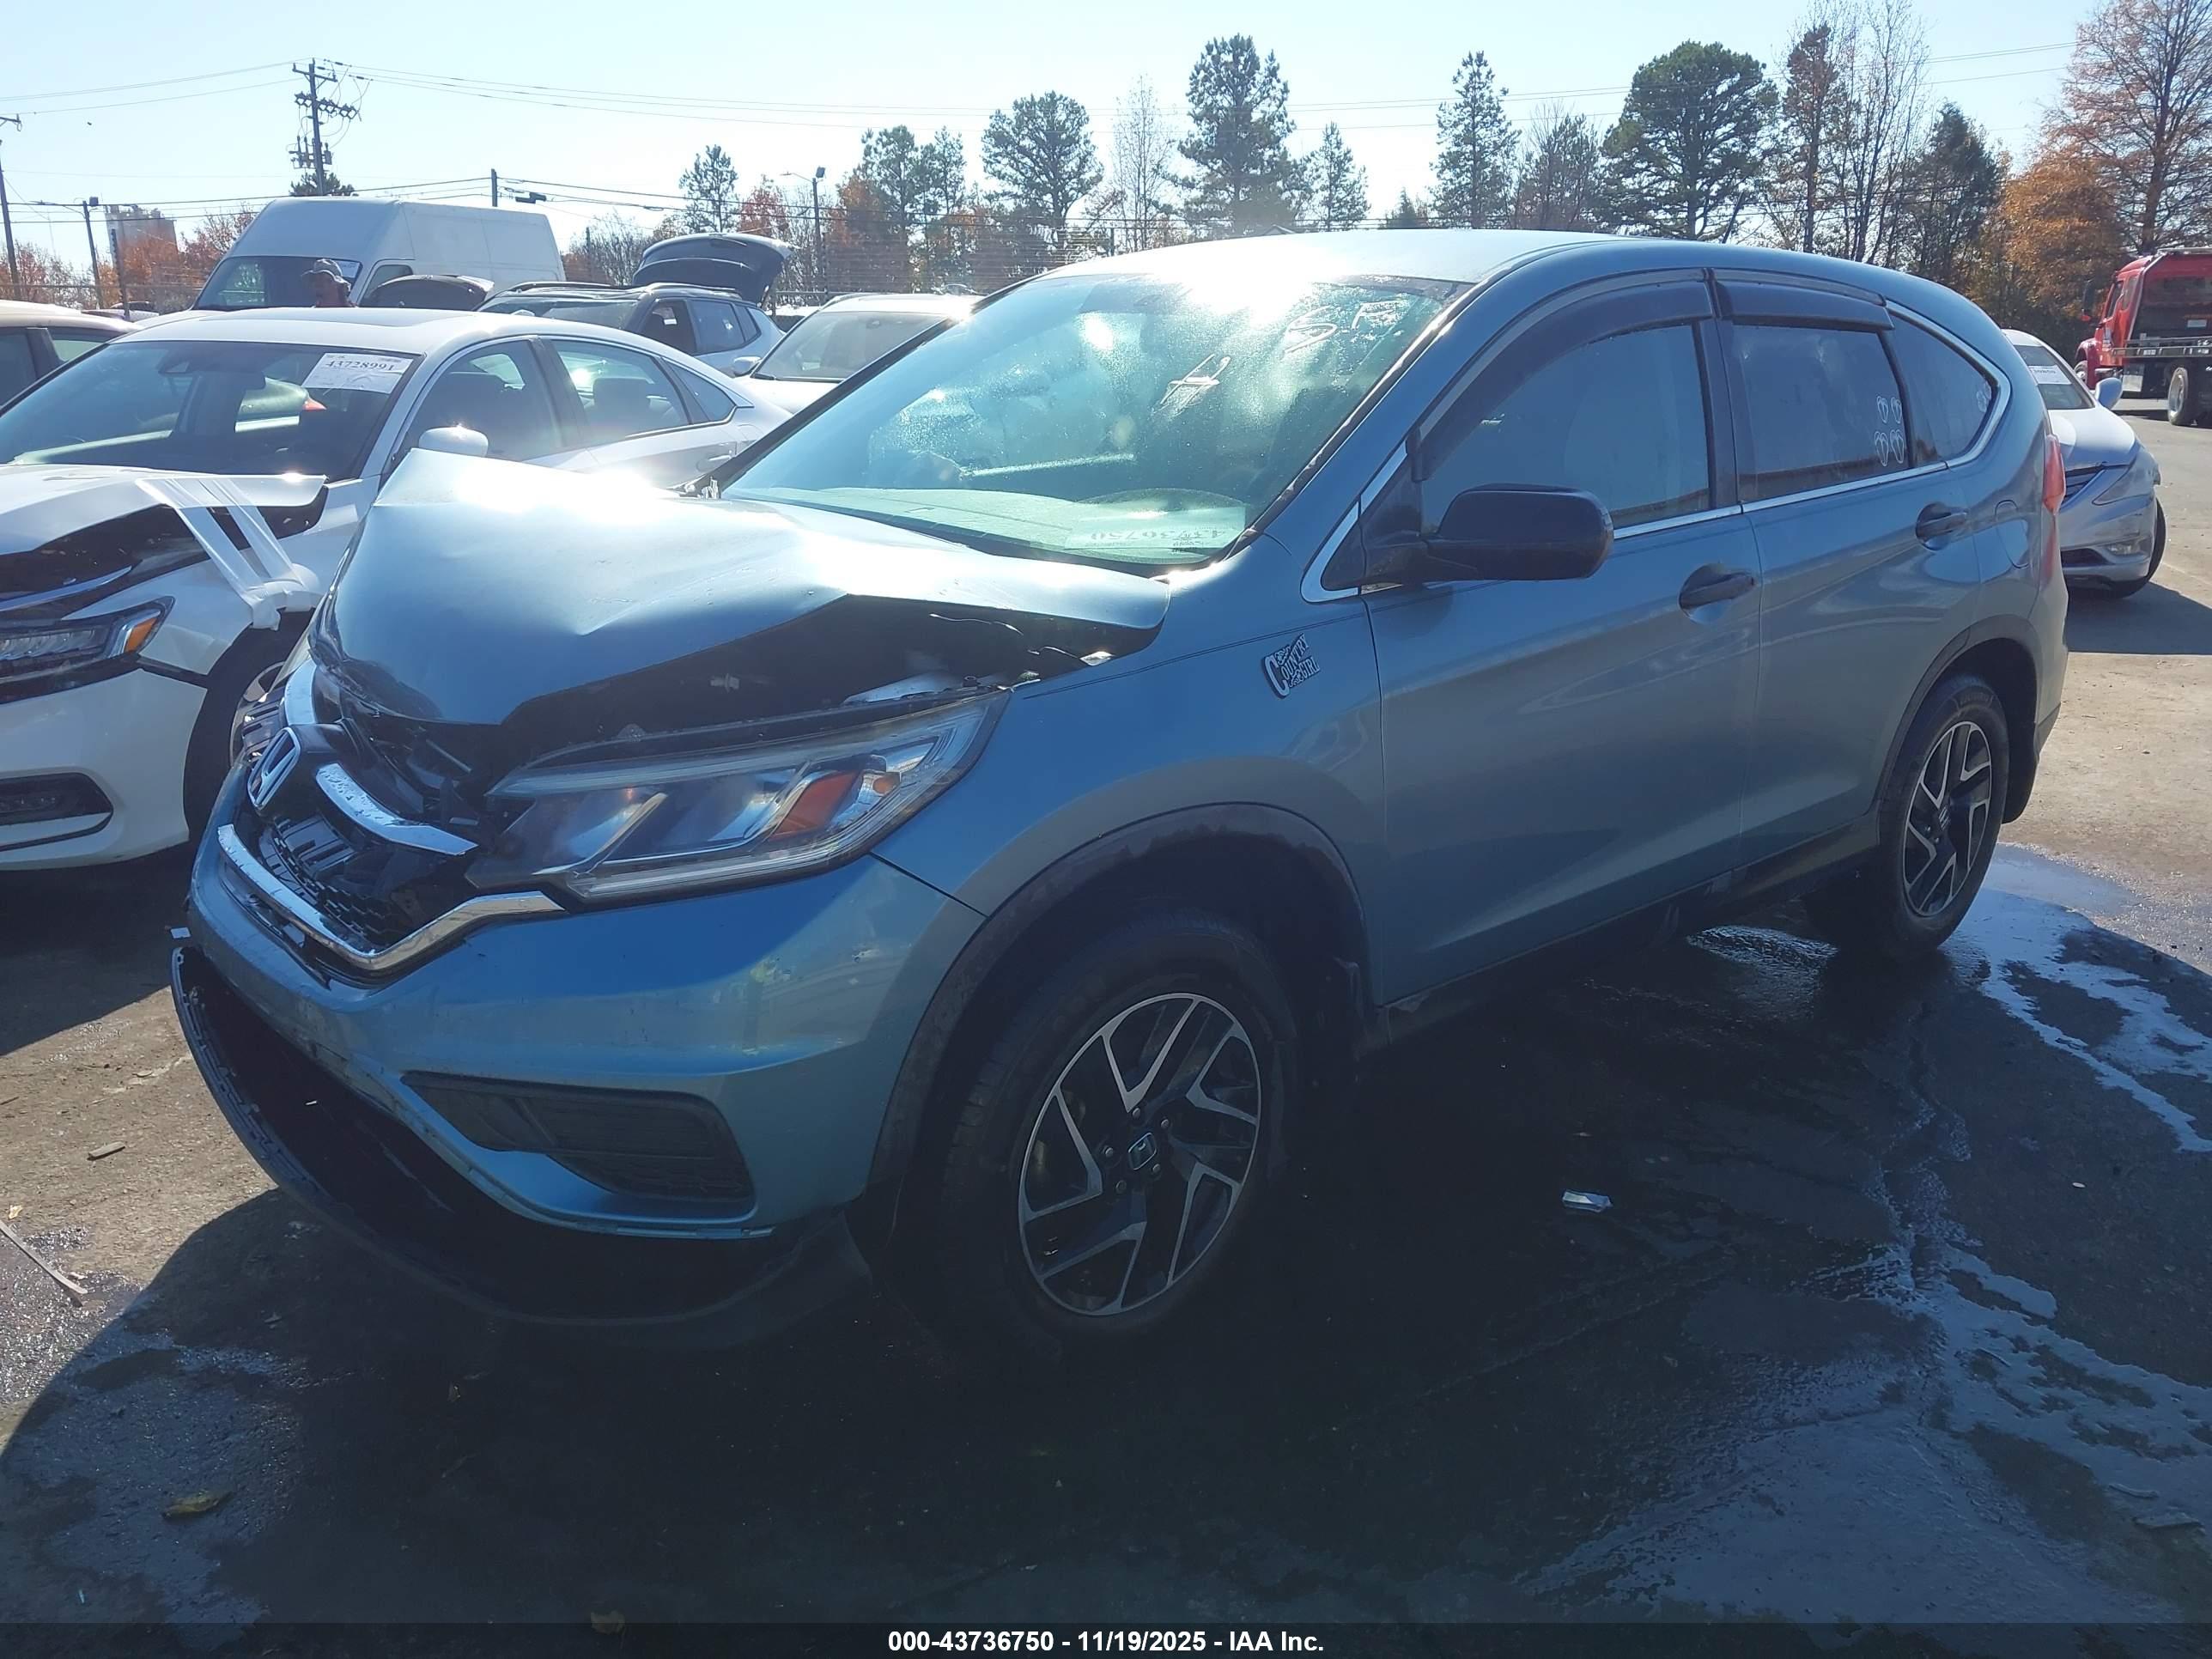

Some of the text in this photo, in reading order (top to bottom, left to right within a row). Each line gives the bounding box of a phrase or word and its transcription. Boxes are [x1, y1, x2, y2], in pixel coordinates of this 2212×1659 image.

[325, 360, 396, 371] 43728991
[1264, 632, 1310, 696] COUNTRY
[1297, 656, 1321, 678] GIRL
